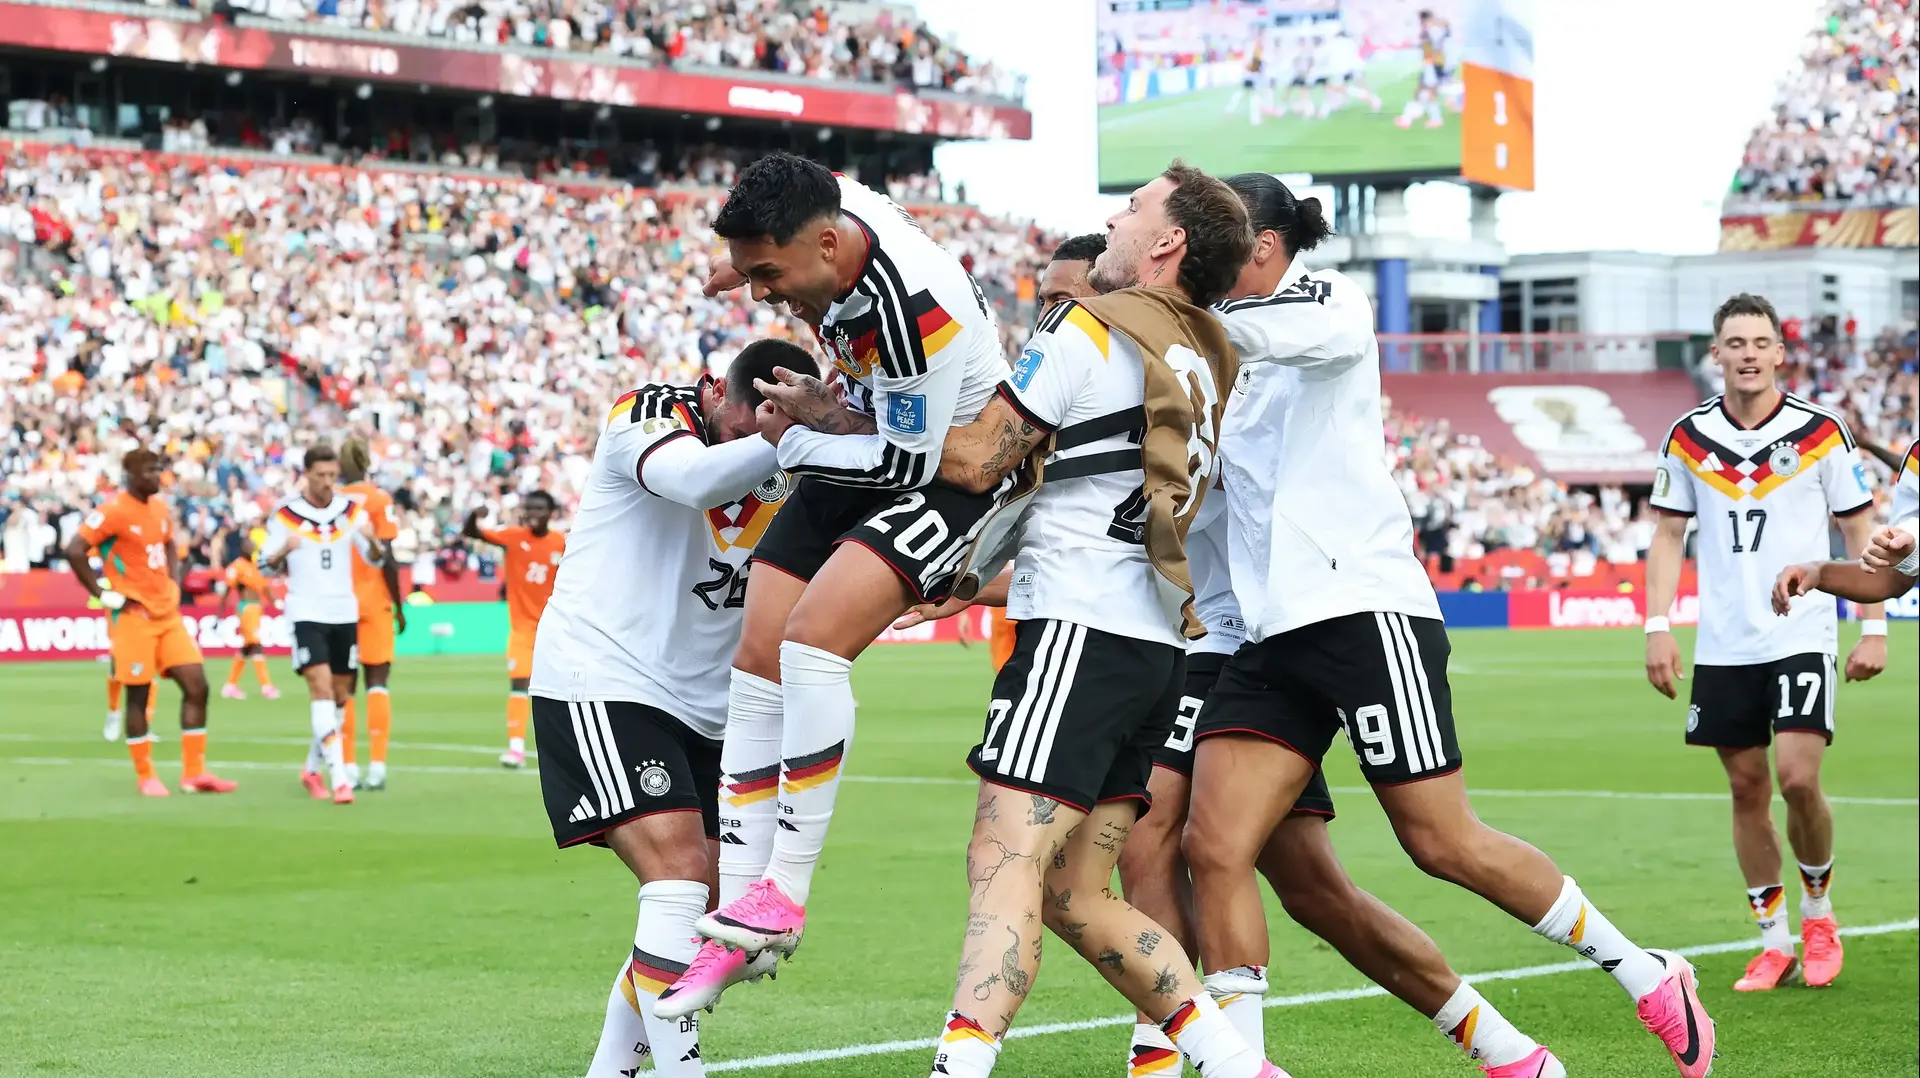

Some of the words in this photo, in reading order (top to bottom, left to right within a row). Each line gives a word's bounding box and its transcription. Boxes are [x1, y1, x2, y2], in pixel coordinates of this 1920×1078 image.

[897, 416, 915, 426] PEACE
[864, 491, 949, 561] 20
[1728, 509, 1767, 553] 17
[321, 549, 332, 570] 8
[23, 616, 111, 651] WORL
[1778, 672, 1821, 718] 17
[979, 698, 1013, 761] 2
[1164, 695, 1204, 752] 3
[633, 1041, 652, 1057] DF
